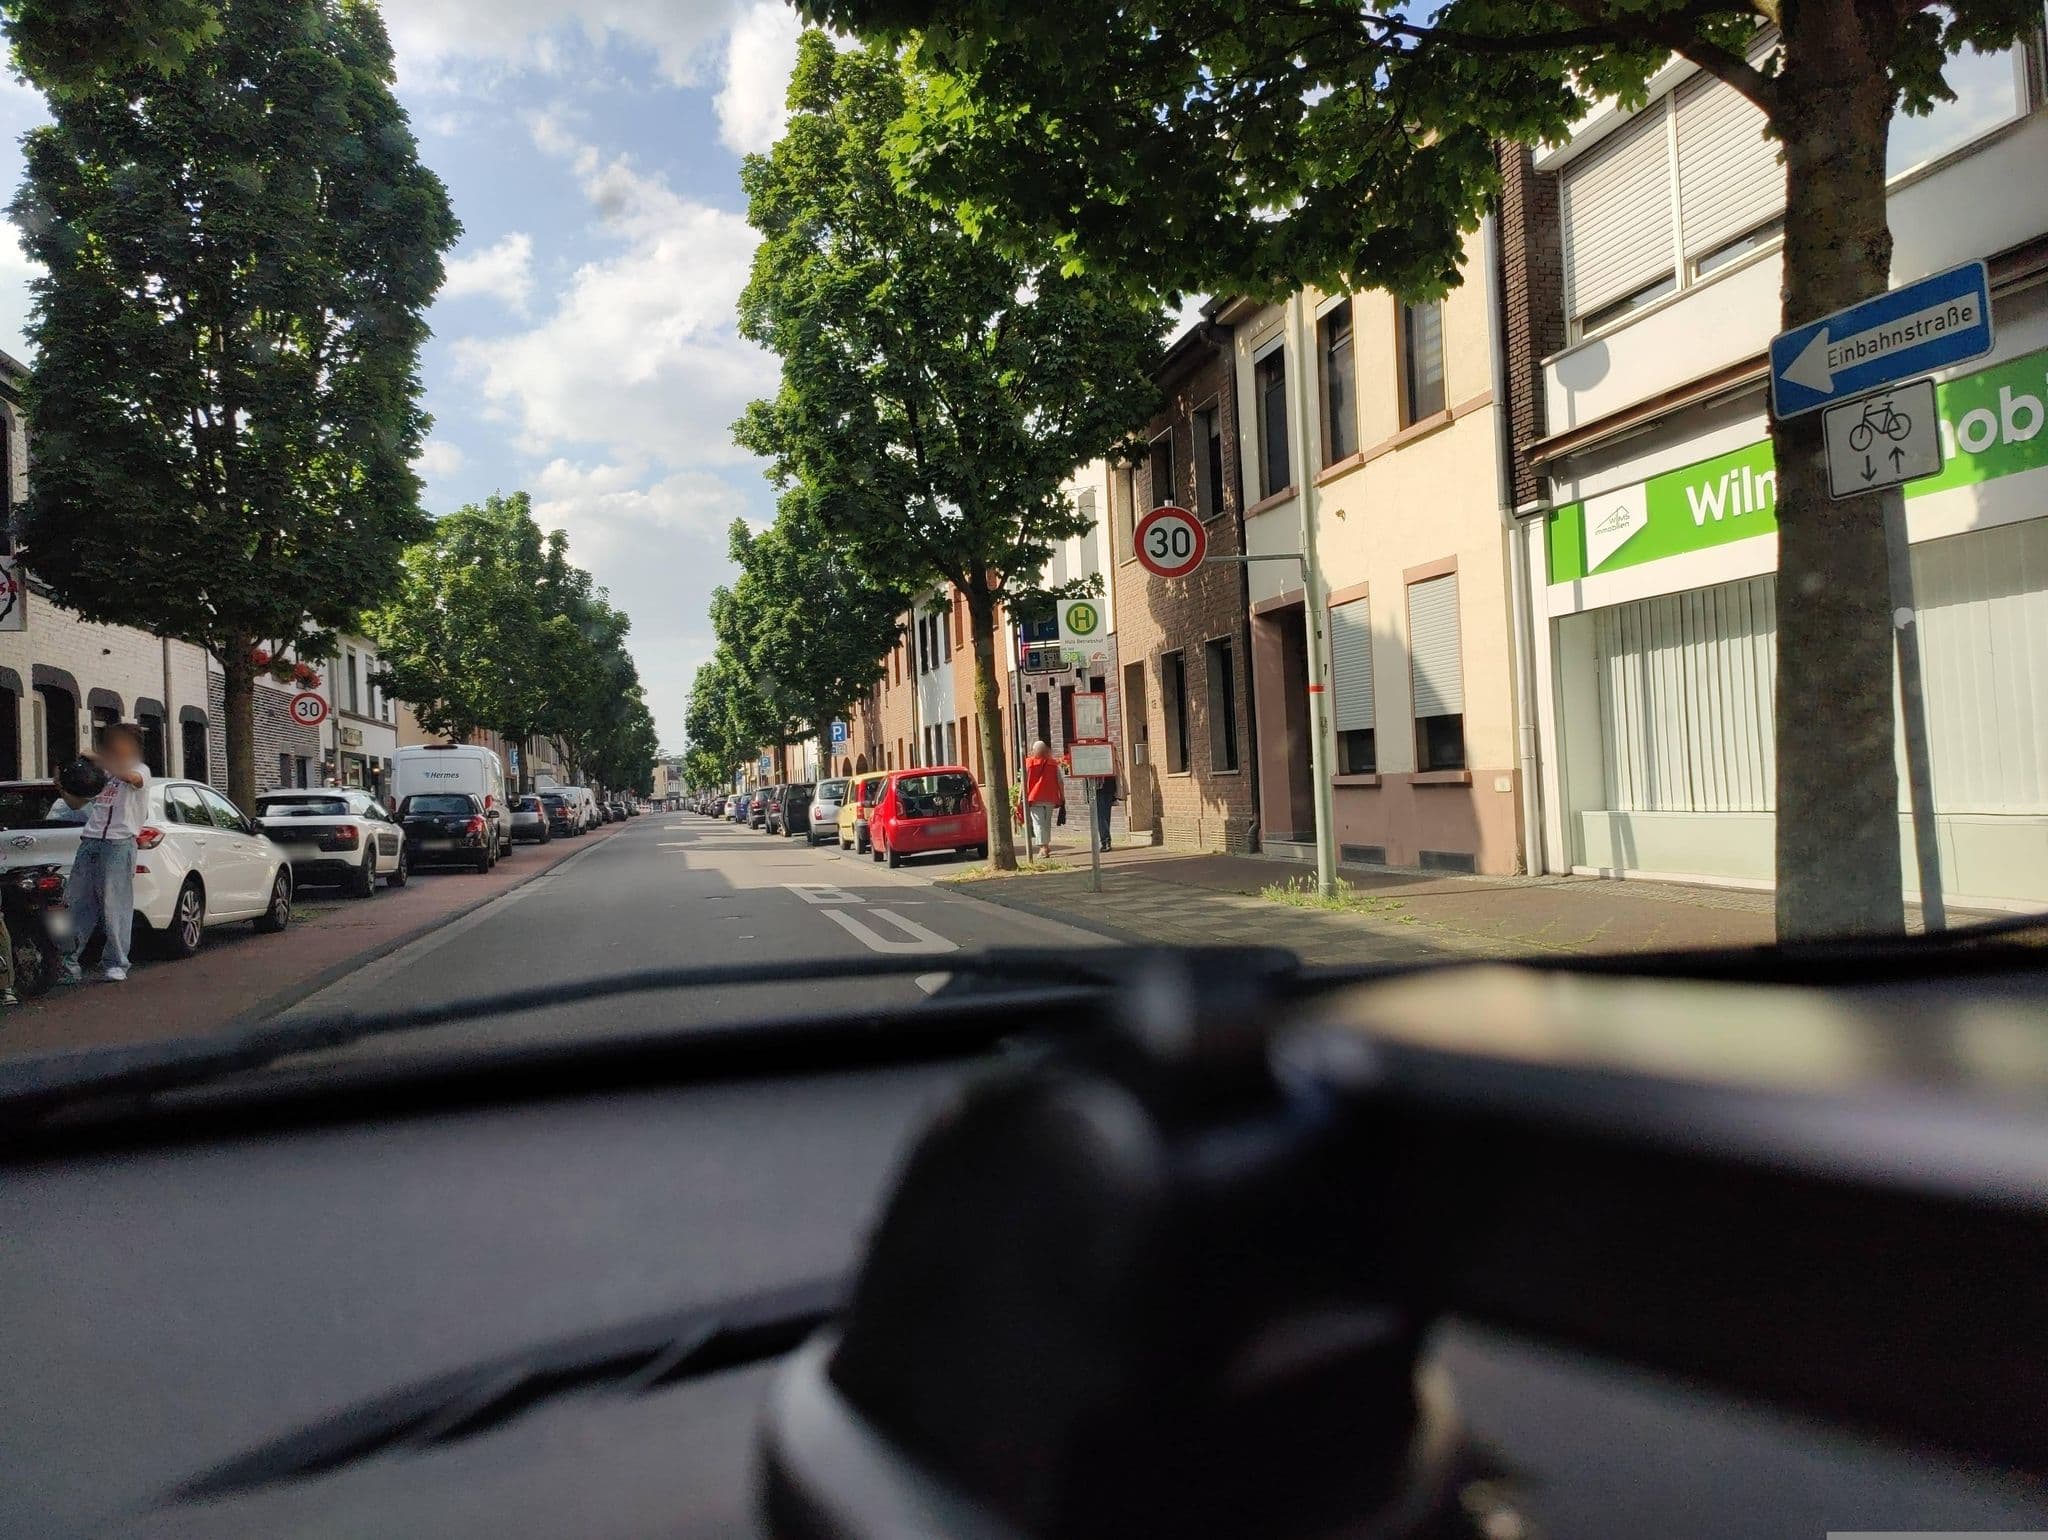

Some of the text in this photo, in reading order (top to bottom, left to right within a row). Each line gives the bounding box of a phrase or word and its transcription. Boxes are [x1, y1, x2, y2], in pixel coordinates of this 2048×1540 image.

[1827, 305, 1973, 369] Einbahnstraße
[1149, 526, 1190, 558] 30
[1074, 609, 1091, 629] H
[297, 702, 320, 717] 30
[832, 726, 842, 741] P
[430, 771, 460, 779] Hermes
